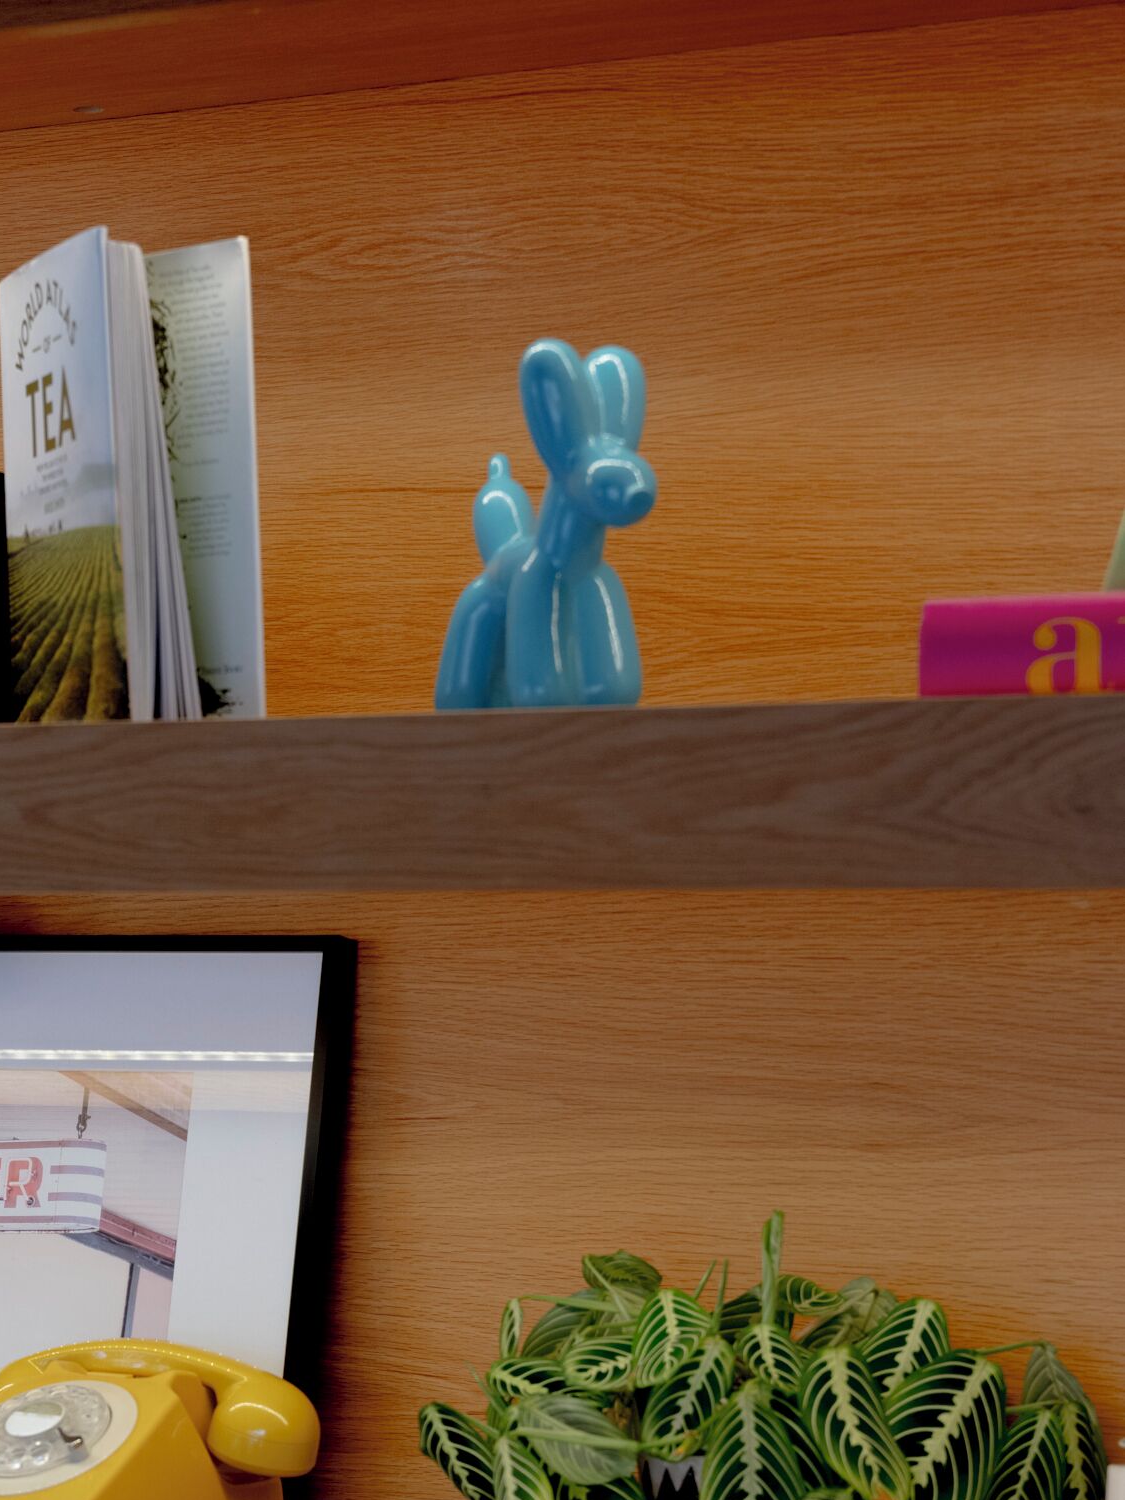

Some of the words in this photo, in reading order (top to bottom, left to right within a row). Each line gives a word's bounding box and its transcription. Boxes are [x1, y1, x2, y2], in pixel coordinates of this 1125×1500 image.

[16, 282, 43, 371] WORLD
[45, 278, 78, 347] ATLAS
[25, 366, 76, 458] TEA
